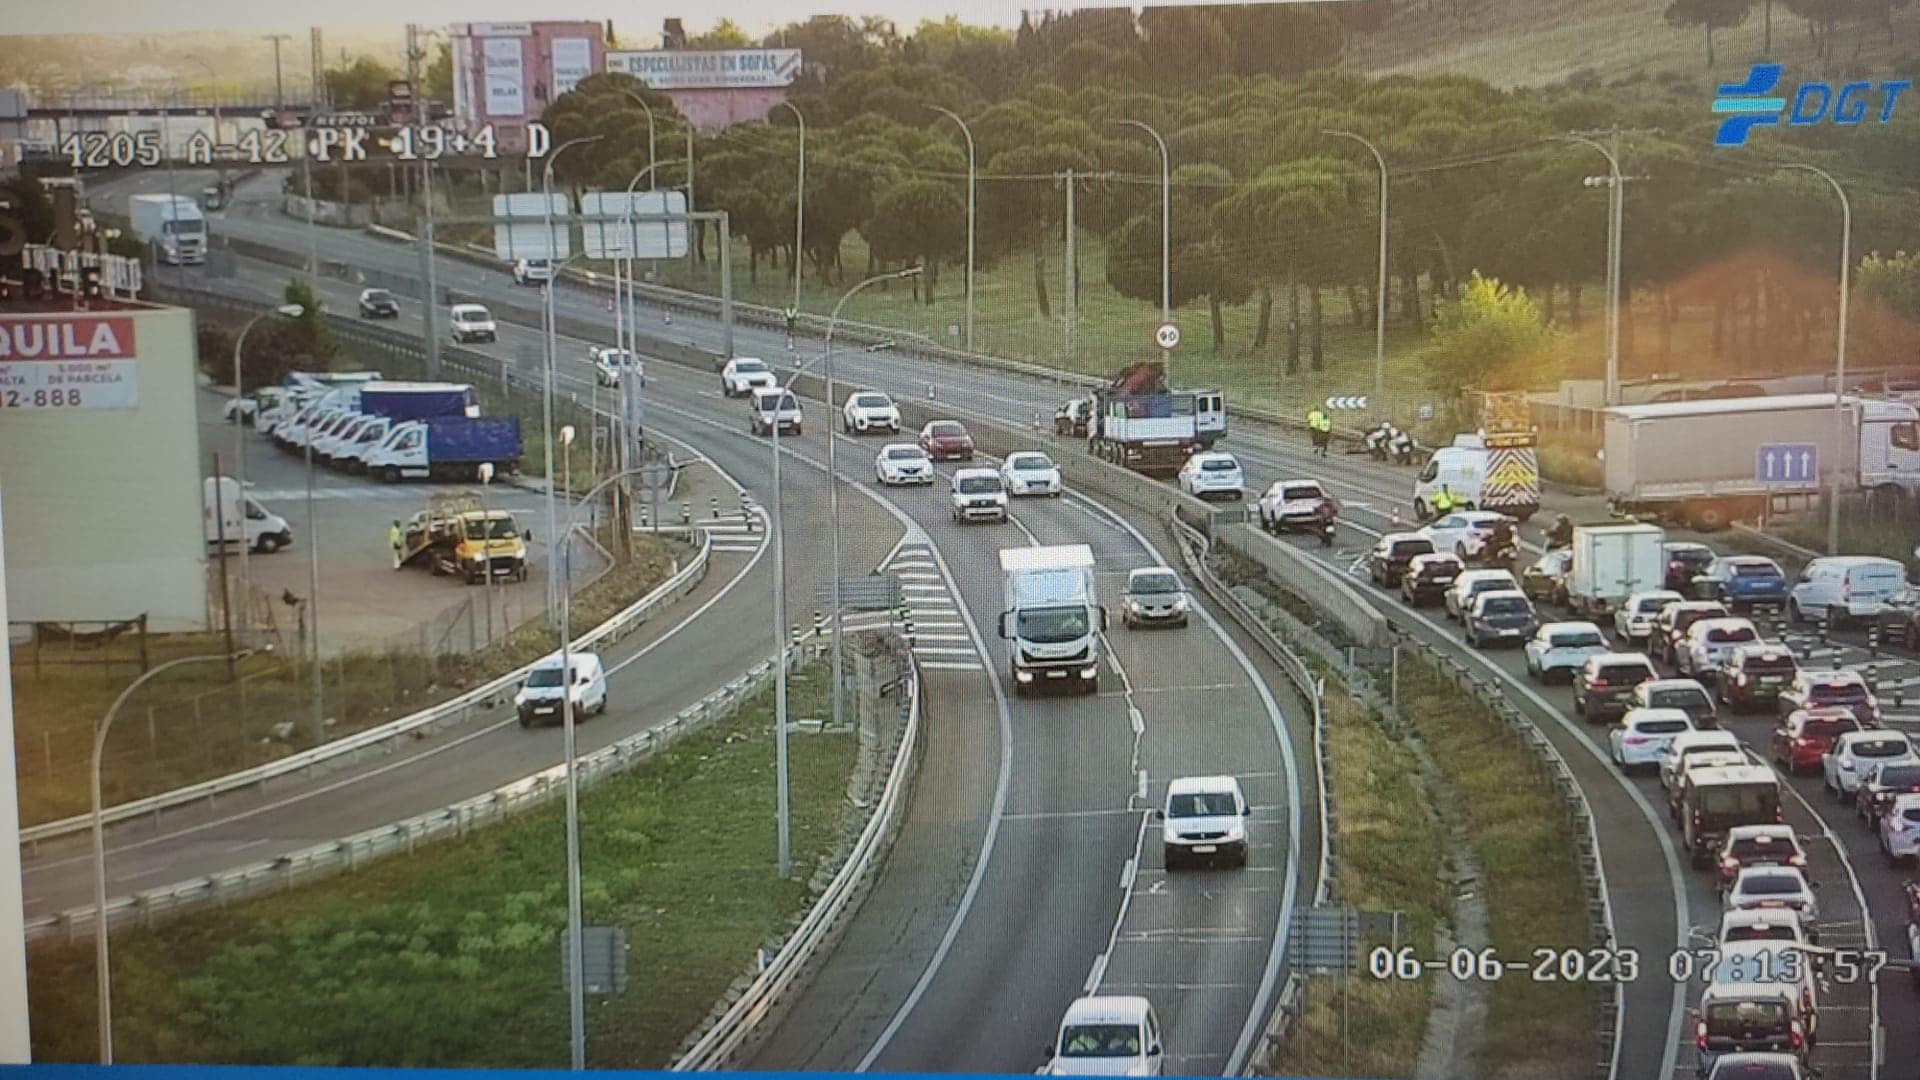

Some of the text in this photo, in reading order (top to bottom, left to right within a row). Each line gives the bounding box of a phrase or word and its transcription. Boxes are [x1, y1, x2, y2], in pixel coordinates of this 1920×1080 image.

[628, 56, 717, 73] ESPECIALISTAS
[719, 56, 737, 72] EN
[48, 373, 122, 384] DE PARCELA
